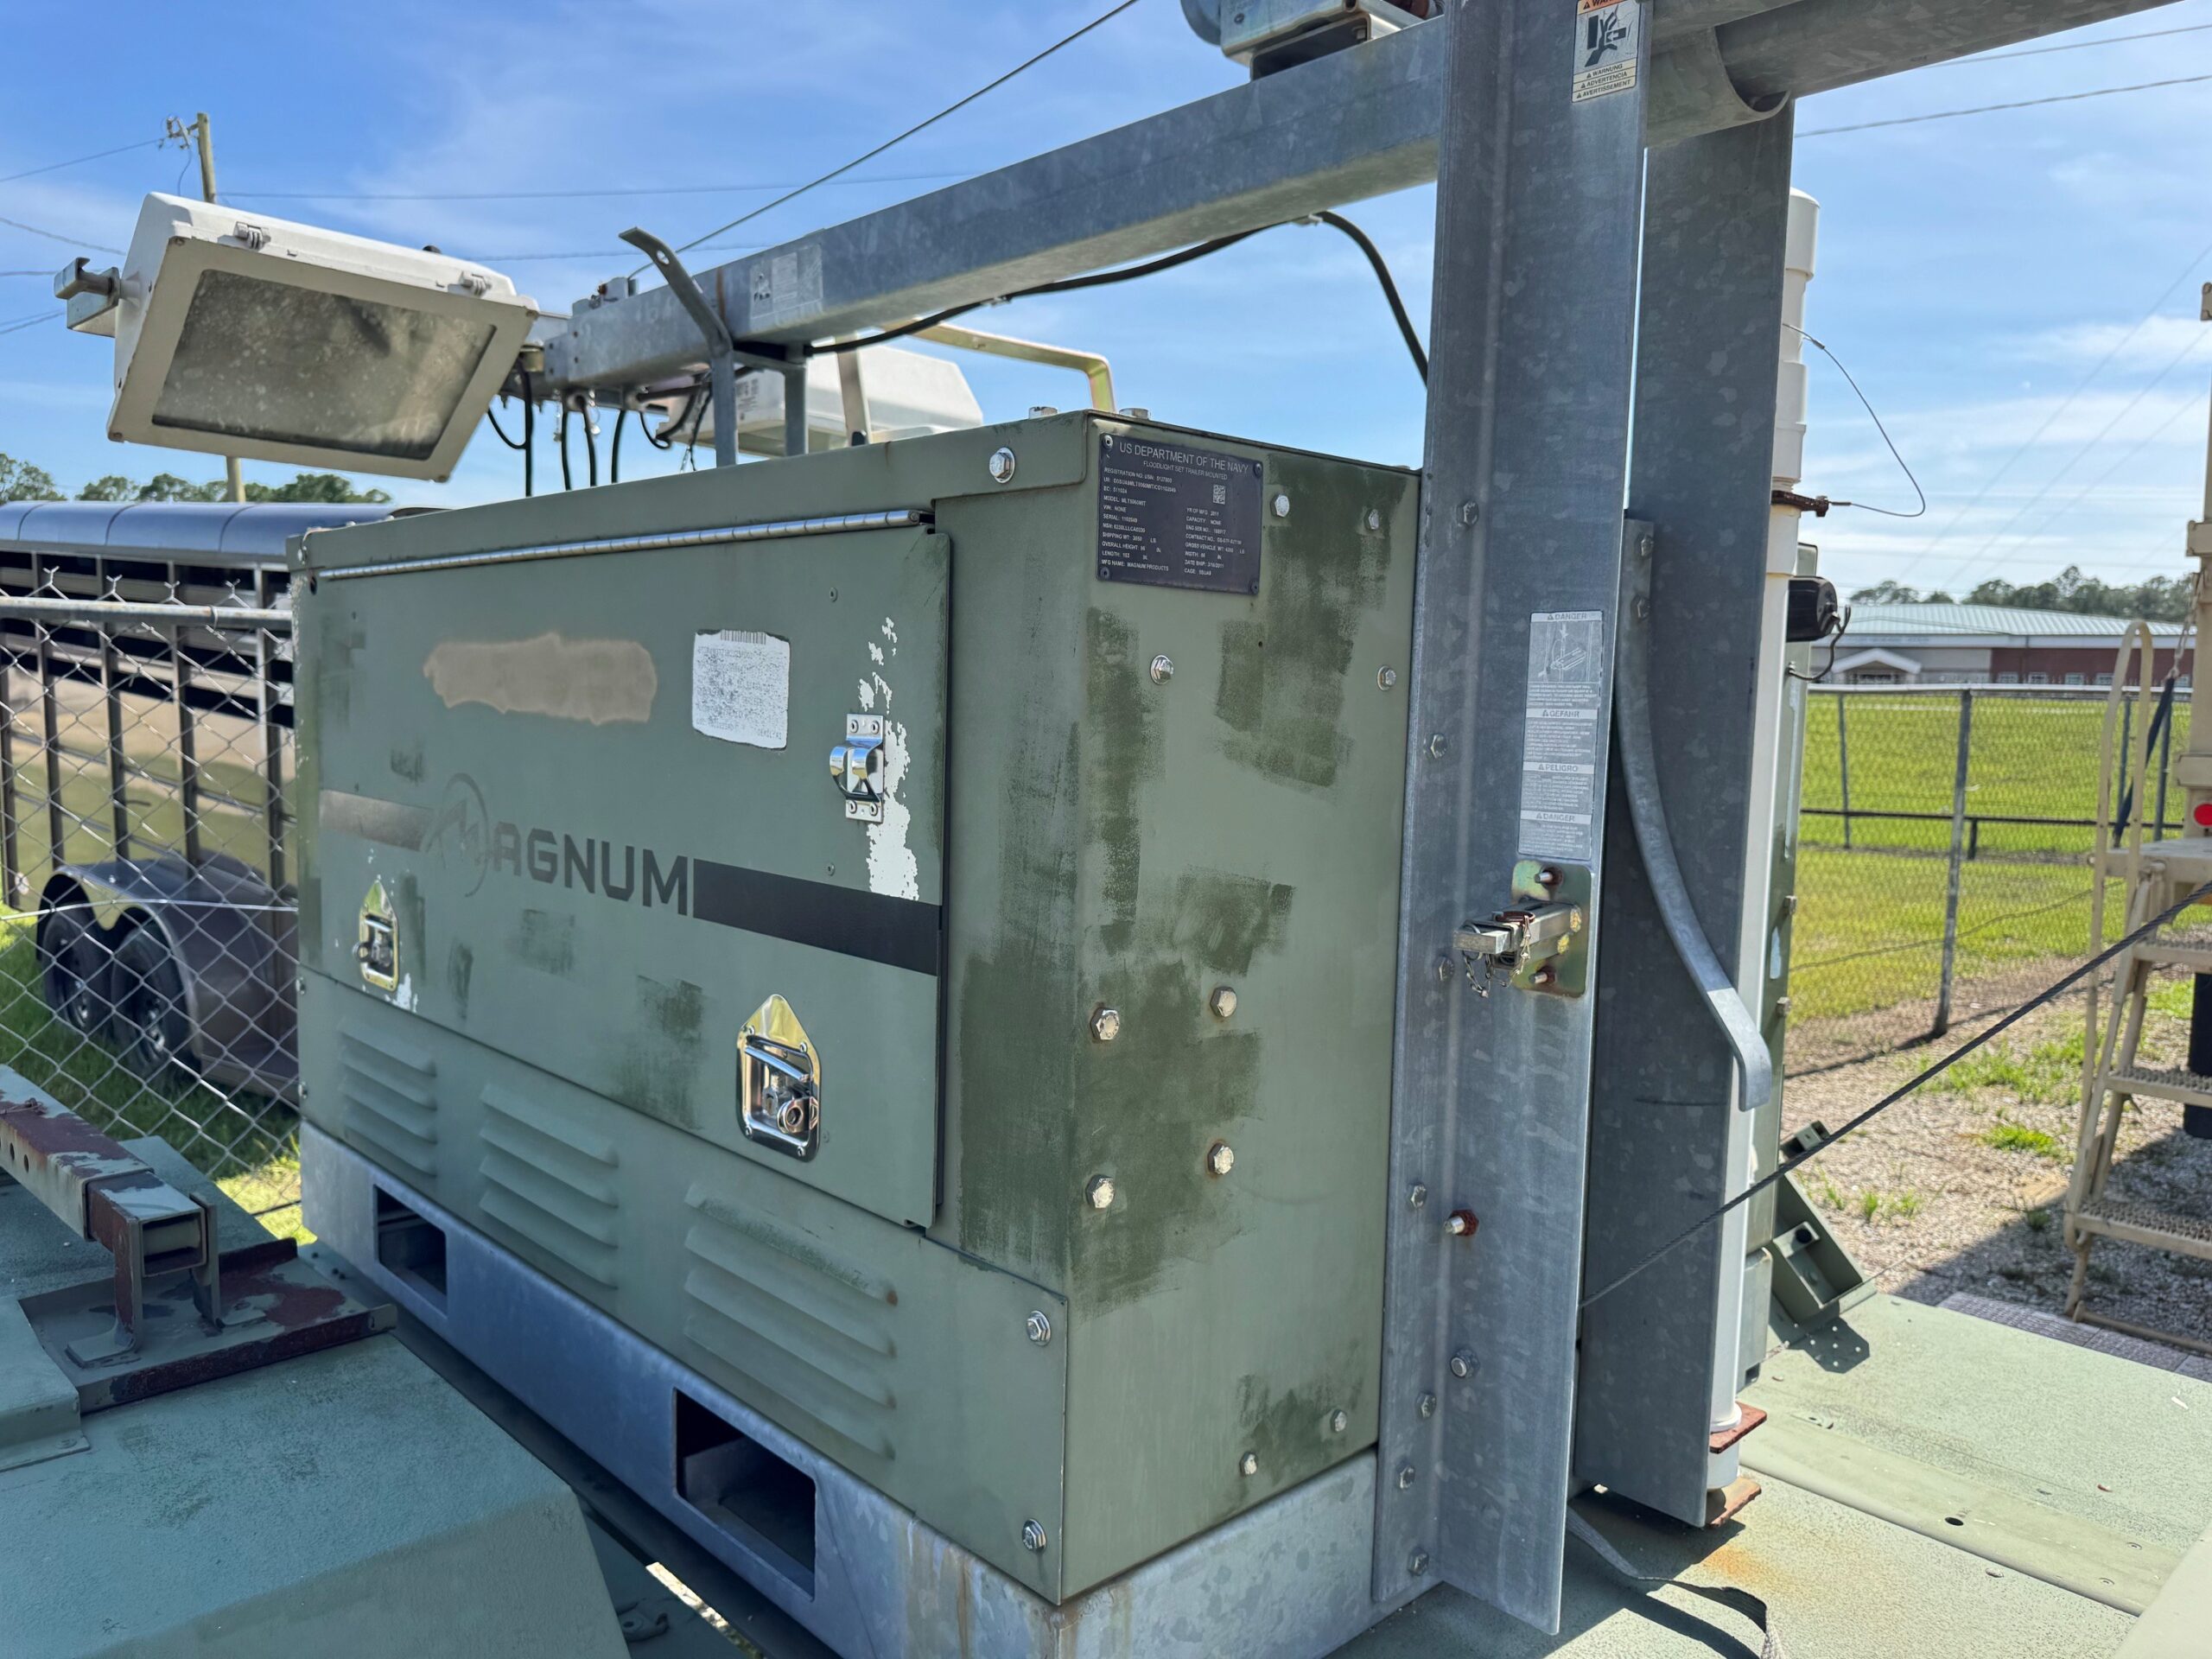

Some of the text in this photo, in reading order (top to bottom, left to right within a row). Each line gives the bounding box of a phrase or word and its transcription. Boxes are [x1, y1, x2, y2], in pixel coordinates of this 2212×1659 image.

[1592, 63, 1623, 77] WARNUNG
[1586, 71, 1628, 86] ADVERTENCIA
[1582, 79, 1631, 97] AVERTISSEMENT
[1119, 442, 1249, 474] US DEPARTMENT OF THE NAVY
[1103, 467, 1135, 477] REGISTRATION
[1143, 461, 1174, 472] FLOODLIGHT
[1185, 467, 1205, 476] TRAILER
[1205, 471, 1228, 480] MOUNTED
[1549, 709, 1580, 718] GEFAHR
[1545, 764, 1579, 772] PELIGRO
[1542, 813, 1575, 823] DANGER
